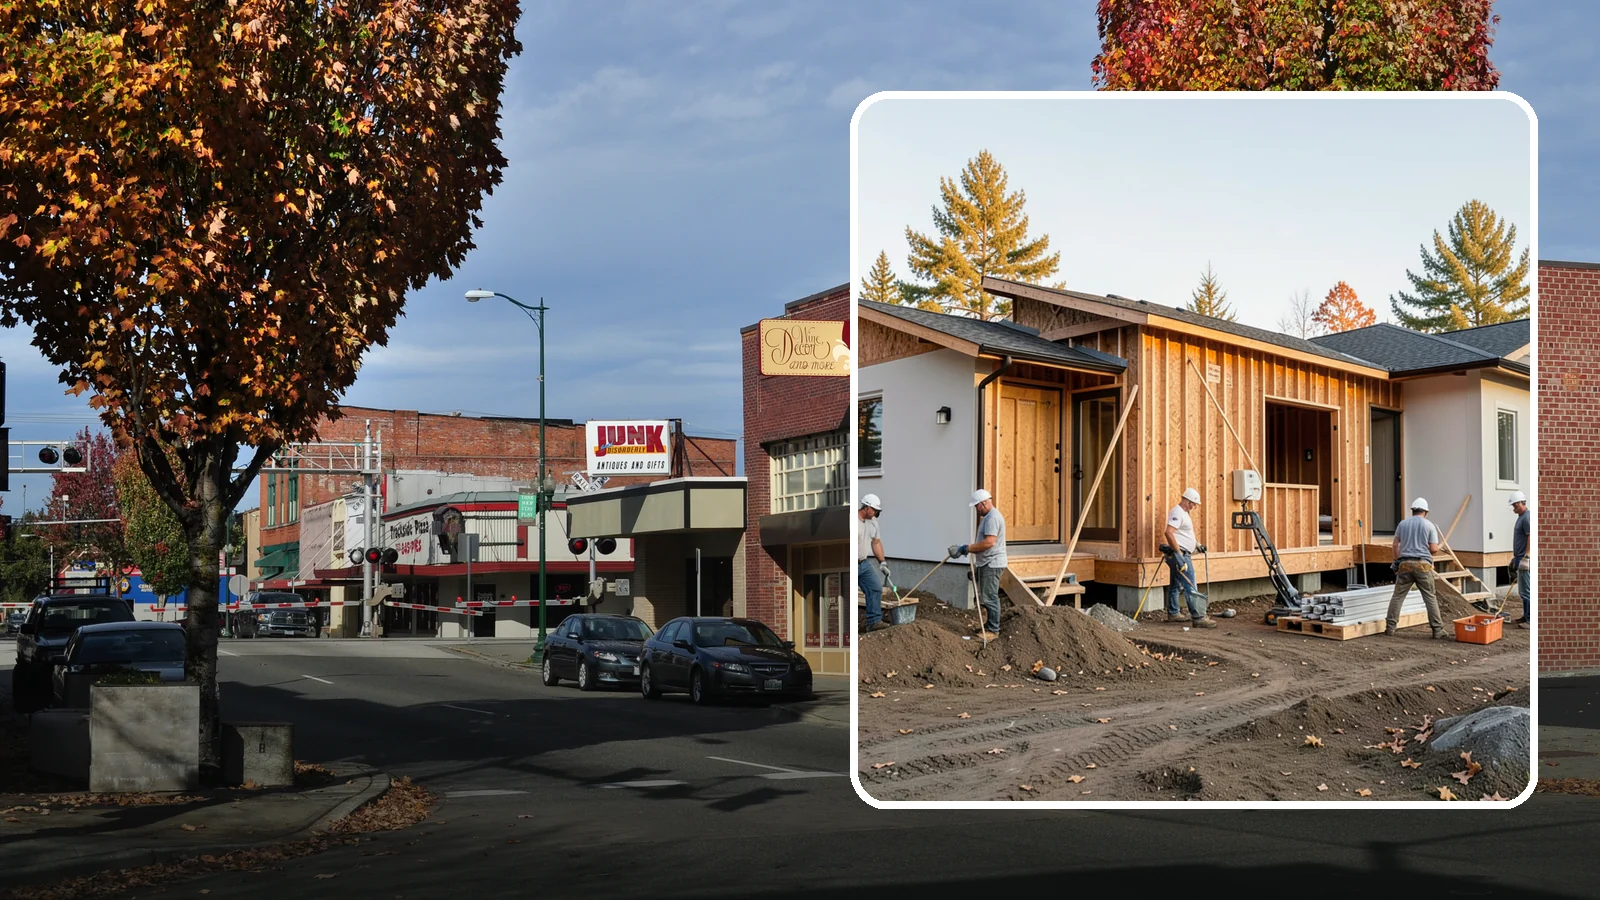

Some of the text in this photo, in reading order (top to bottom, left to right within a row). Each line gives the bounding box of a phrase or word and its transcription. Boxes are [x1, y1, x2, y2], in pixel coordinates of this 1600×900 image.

[596, 425, 665, 457] JUNK
[607, 446, 646, 454] DISORDERLY
[597, 460, 665, 470] ANTIQUES AND GIFTS
[573, 473, 589, 491] RAIL
